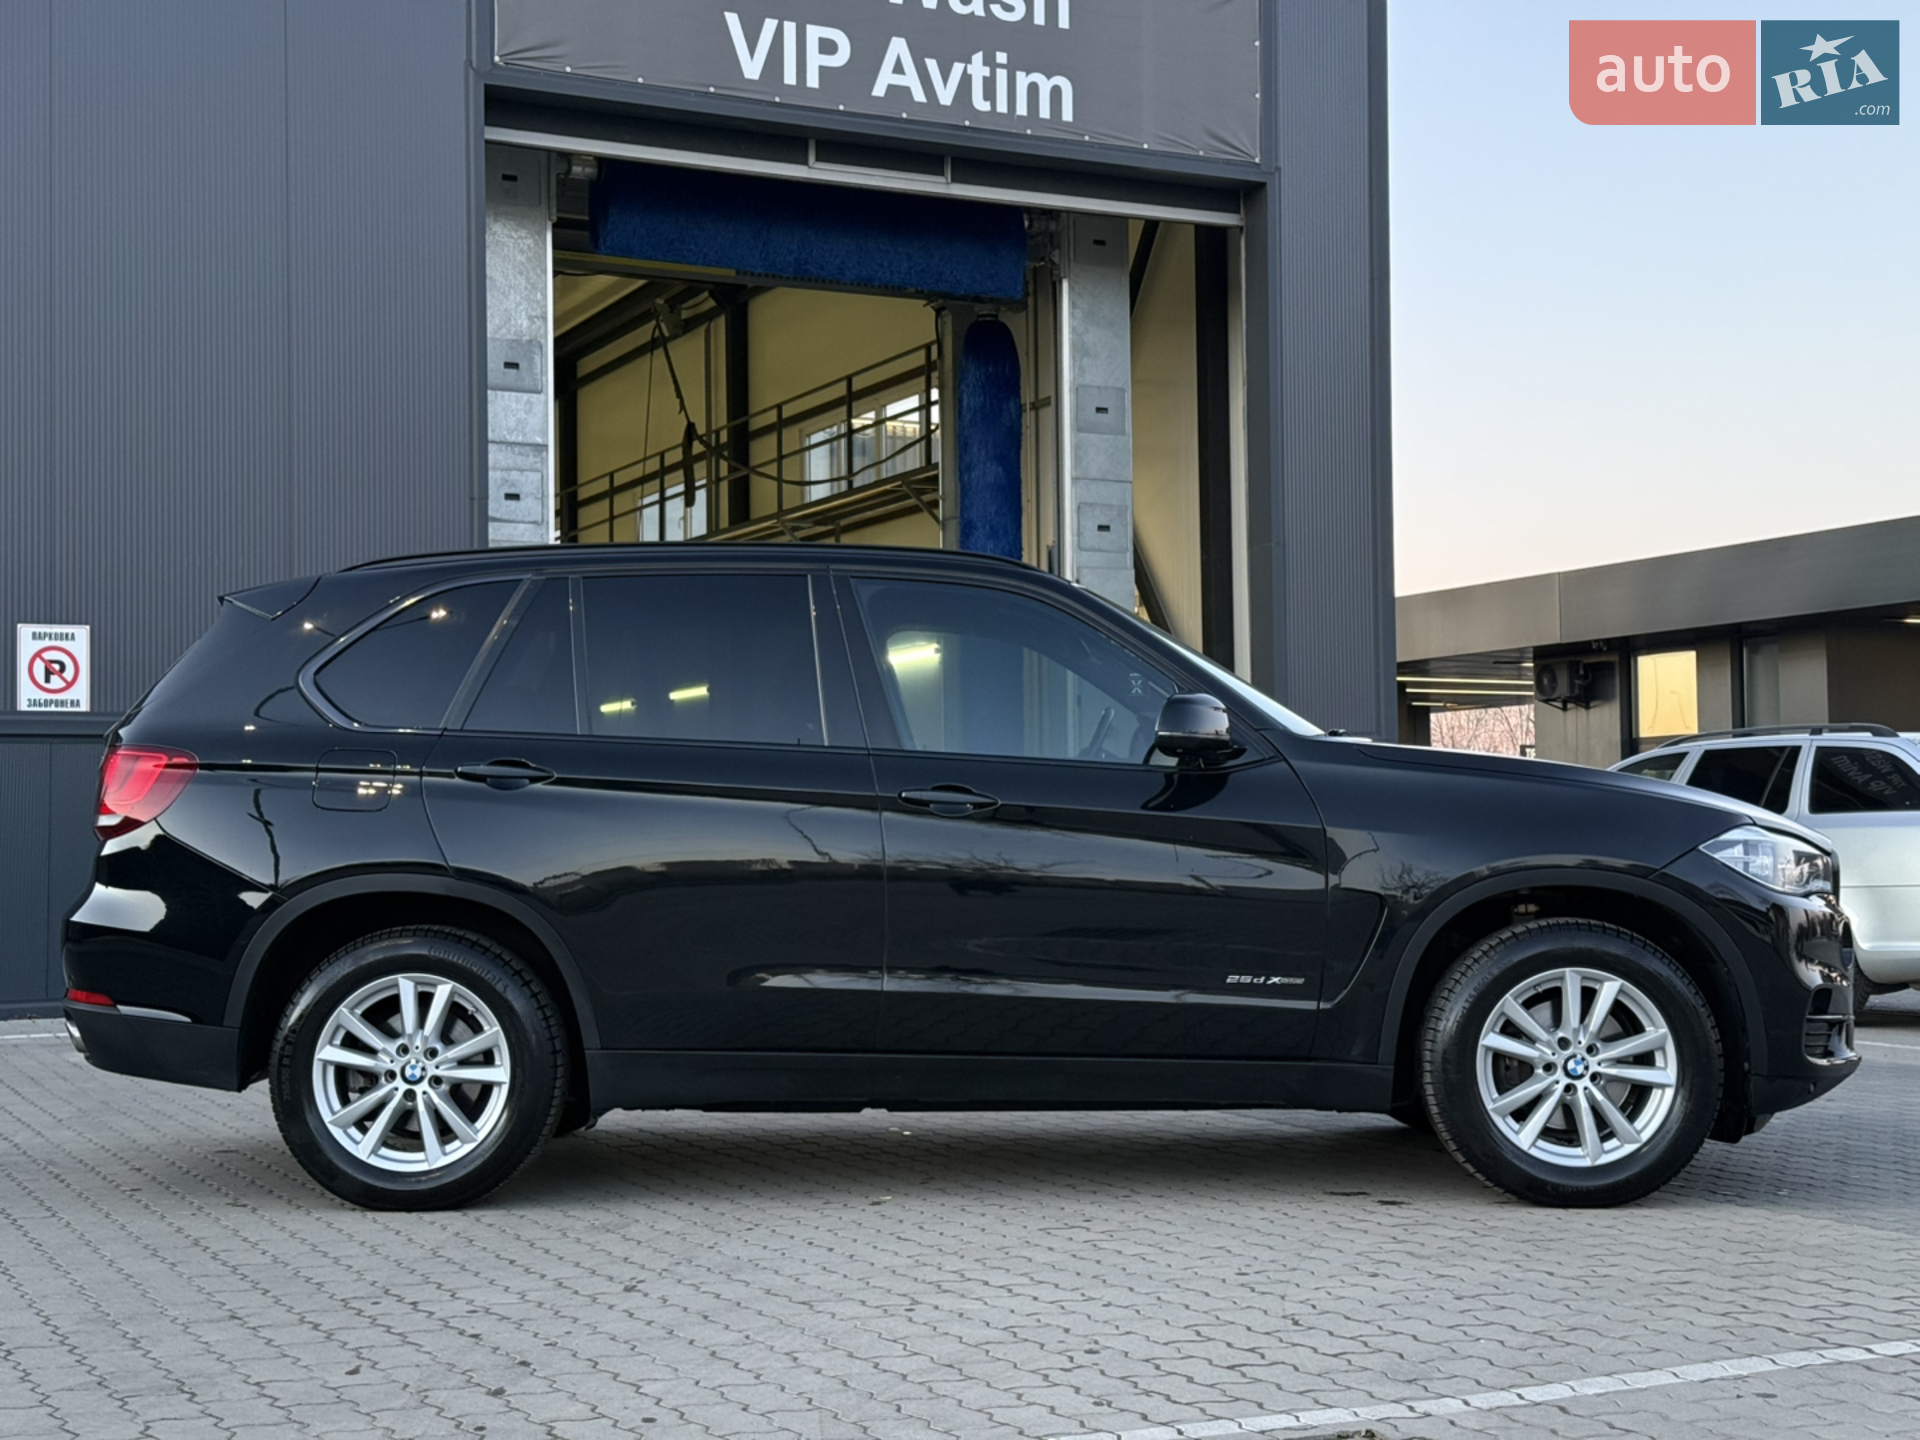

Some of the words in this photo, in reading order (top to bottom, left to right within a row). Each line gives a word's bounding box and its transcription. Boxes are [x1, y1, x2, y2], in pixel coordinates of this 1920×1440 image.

[723, 11, 851, 89] VIP
[871, 36, 1074, 122] Avtim
[31, 631, 76, 641] ПАРКОВКА
[26, 698, 81, 709] ЗАБОРОНЕНА
